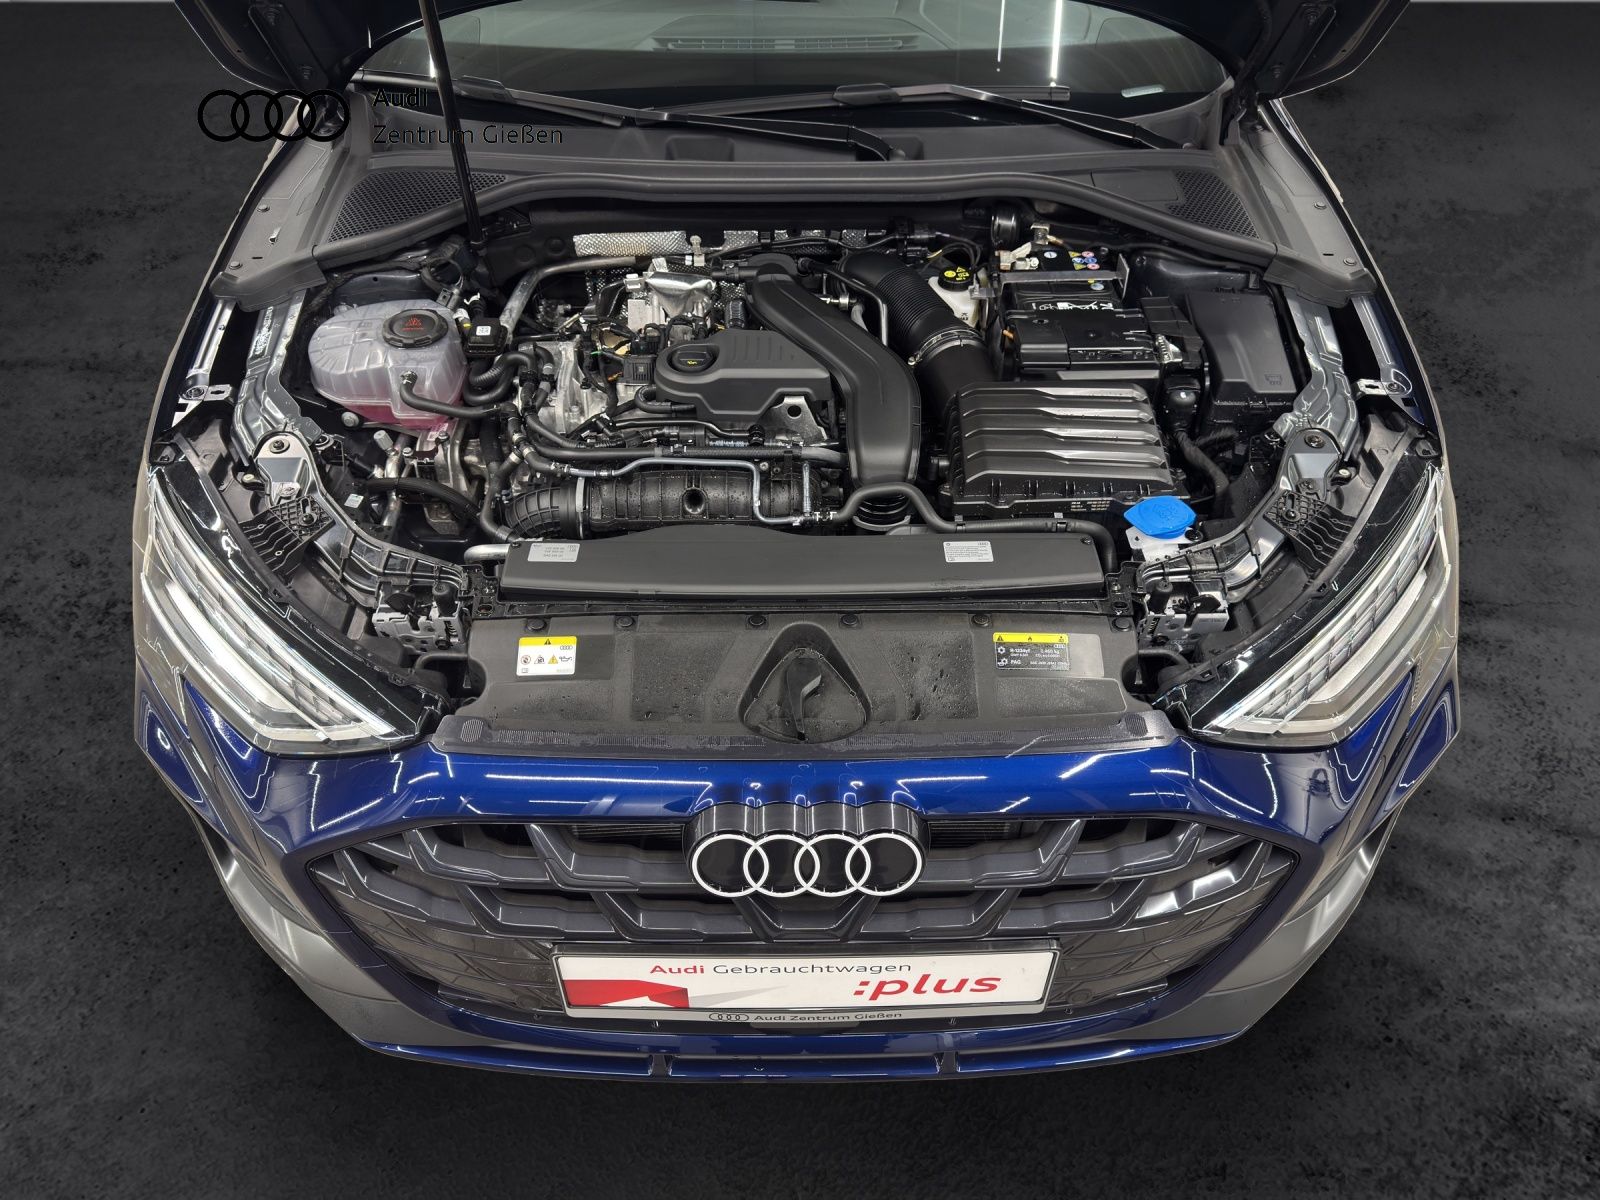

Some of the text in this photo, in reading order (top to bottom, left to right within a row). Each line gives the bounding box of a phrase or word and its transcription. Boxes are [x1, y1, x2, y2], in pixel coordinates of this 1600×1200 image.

[649, 962, 912, 975] Audi Gebrauchtwagen
[854, 1012, 902, 1020] Gießen
